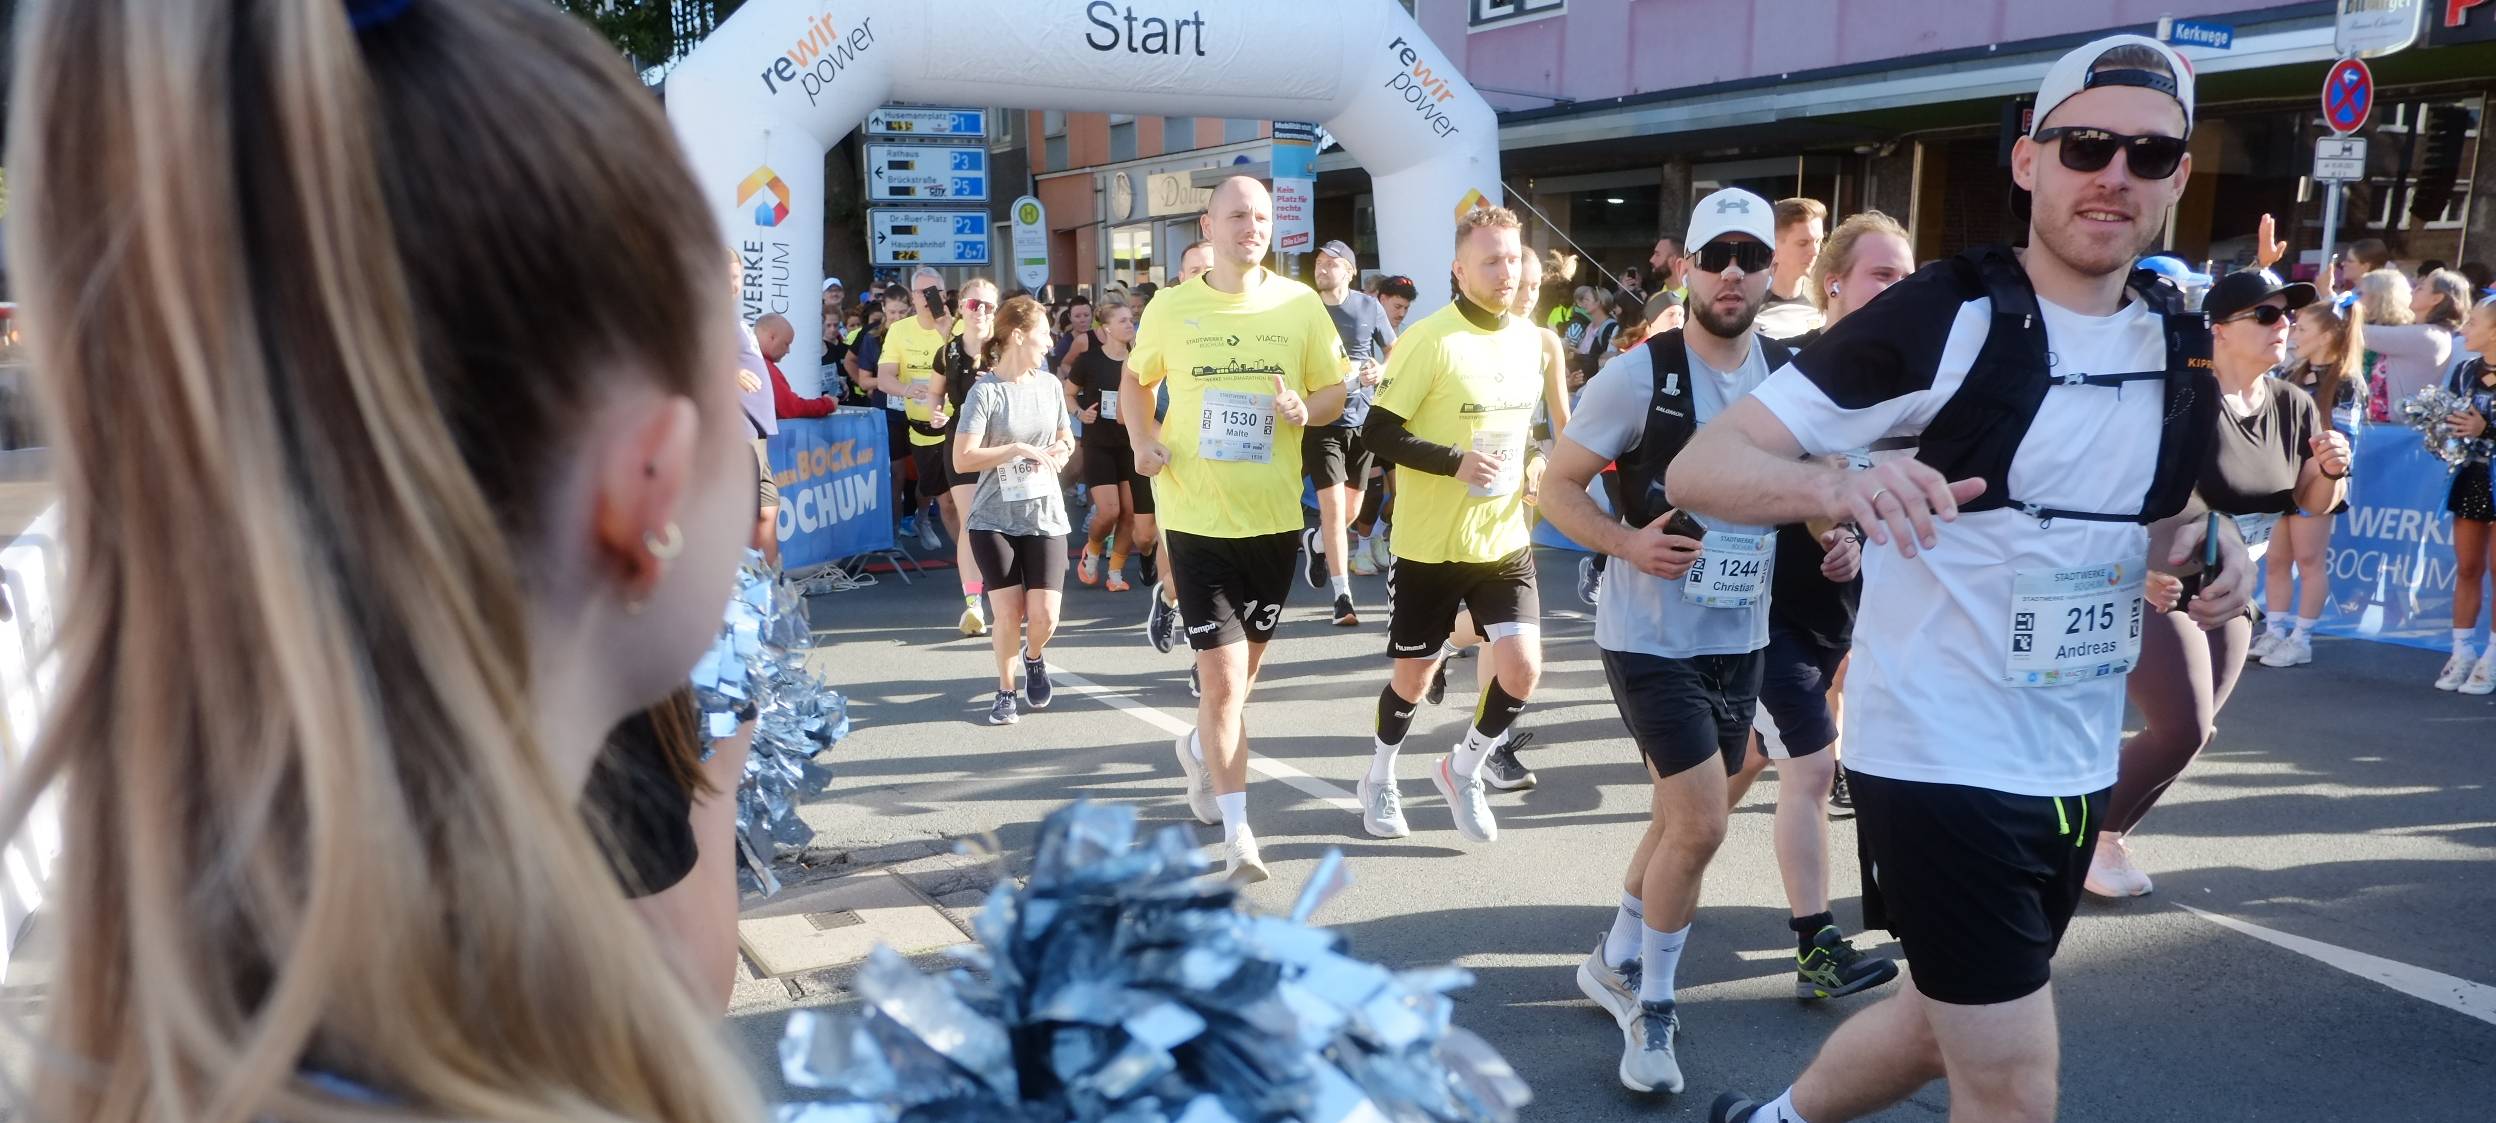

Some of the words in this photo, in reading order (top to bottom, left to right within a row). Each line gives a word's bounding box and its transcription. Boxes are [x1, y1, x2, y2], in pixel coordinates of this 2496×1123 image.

[1085, 1, 1205, 56] Start
[2175, 23, 2229, 47] Kerkwege
[761, 12, 837, 95] rewir
[801, 17, 874, 107] power
[1389, 36, 1454, 103] rewir
[1385, 71, 1459, 138] power
[884, 112, 947, 121] Husemannplatz
[950, 114, 966, 131] P1
[886, 149, 920, 158] Rathaus
[951, 152, 969, 170] P3
[888, 175, 937, 185] Brückstraße
[952, 178, 970, 195] P5
[1276, 186, 1295, 194] Kein
[1276, 195, 1297, 203] Platz
[1298, 194, 1308, 203] für
[1276, 204, 1302, 212] rechte
[955, 216, 972, 234] P2
[891, 240, 946, 249] Hauptbahnhof
[1255, 334, 1289, 344] VIACTIV
[1221, 410, 1257, 426] 1530
[1655, 405, 1684, 418] SALOMON
[1226, 428, 1249, 437] Malte
[796, 438, 857, 482] BOCK
[776, 469, 877, 543] OCHUM
[2330, 505, 2455, 546] WERK
[1720, 559, 1760, 577] 1244
[2055, 568, 2107, 582] STADTWERKE
[2325, 546, 2458, 592] BOCHUM
[1713, 581, 1755, 592] Christian
[1243, 599, 1281, 631] 13
[2065, 602, 2114, 635] 215
[1188, 622, 1217, 635] Kempa
[1395, 642, 1427, 652] hummel
[2055, 641, 2117, 660] Andreas
